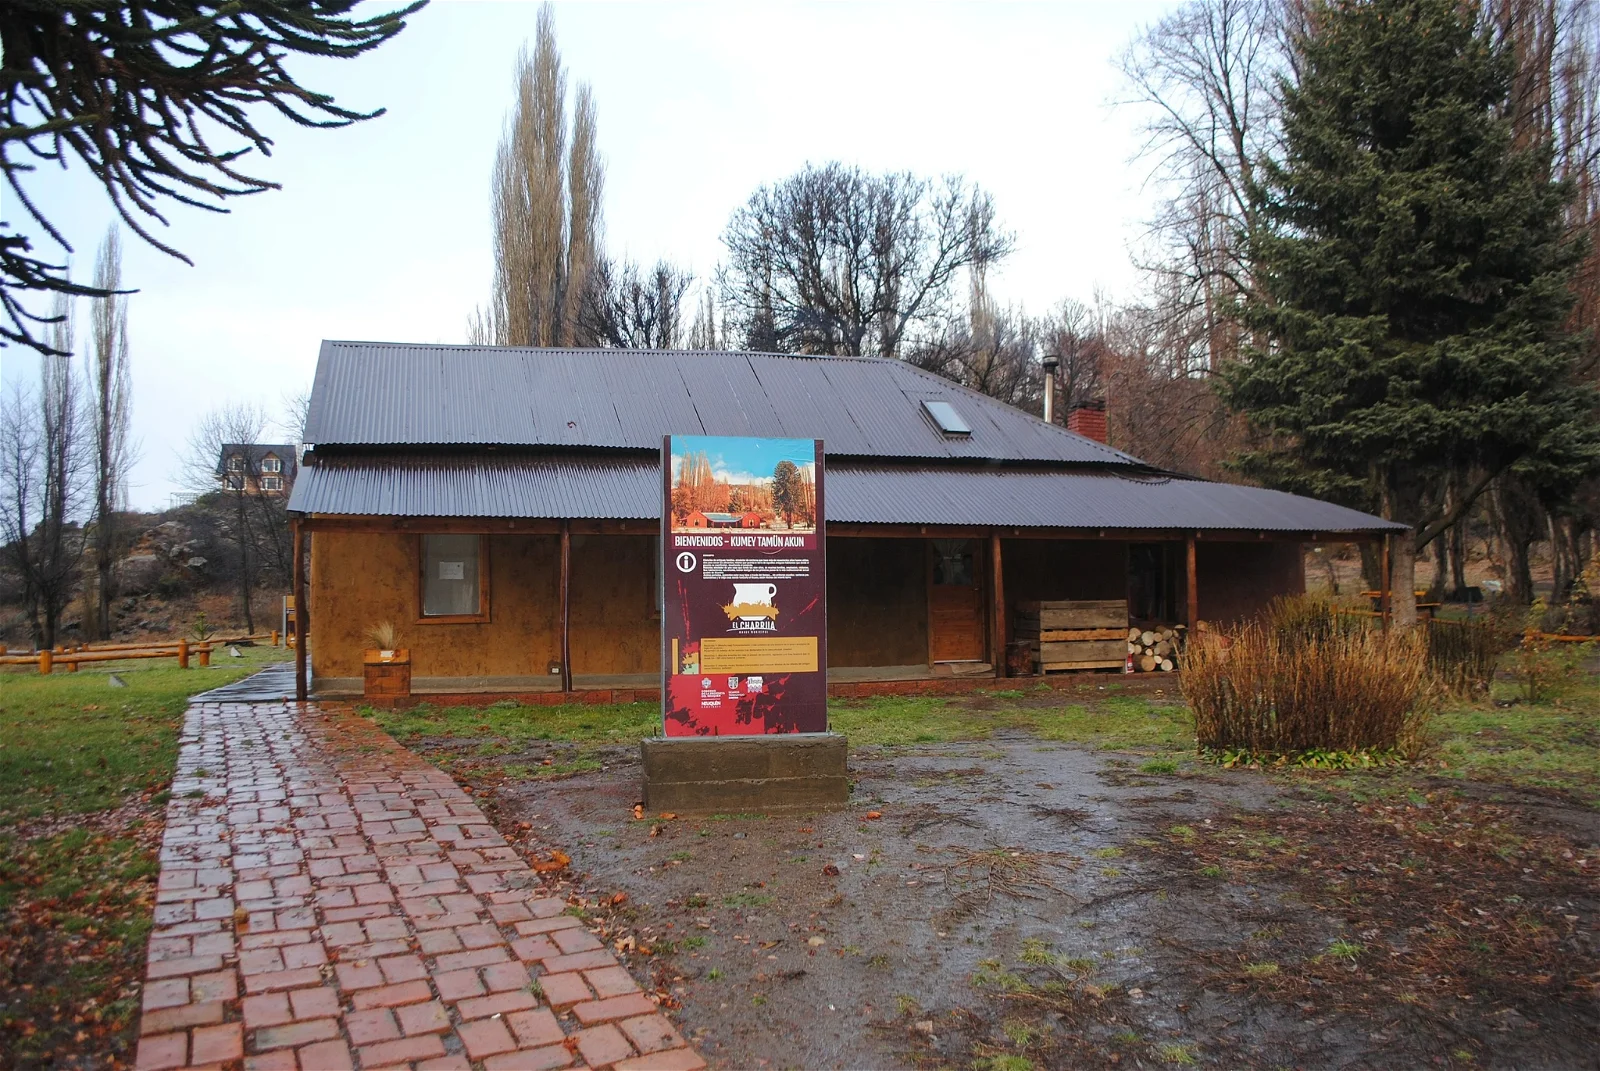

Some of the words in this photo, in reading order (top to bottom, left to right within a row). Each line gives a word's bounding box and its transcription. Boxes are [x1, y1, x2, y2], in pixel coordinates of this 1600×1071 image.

[674, 536, 723, 547] BIENVENIDOS
[730, 536, 756, 547] KUMEY
[757, 535, 783, 547] TAMÜN
[784, 536, 804, 547] AKUN
[732, 621, 738, 629] EL
